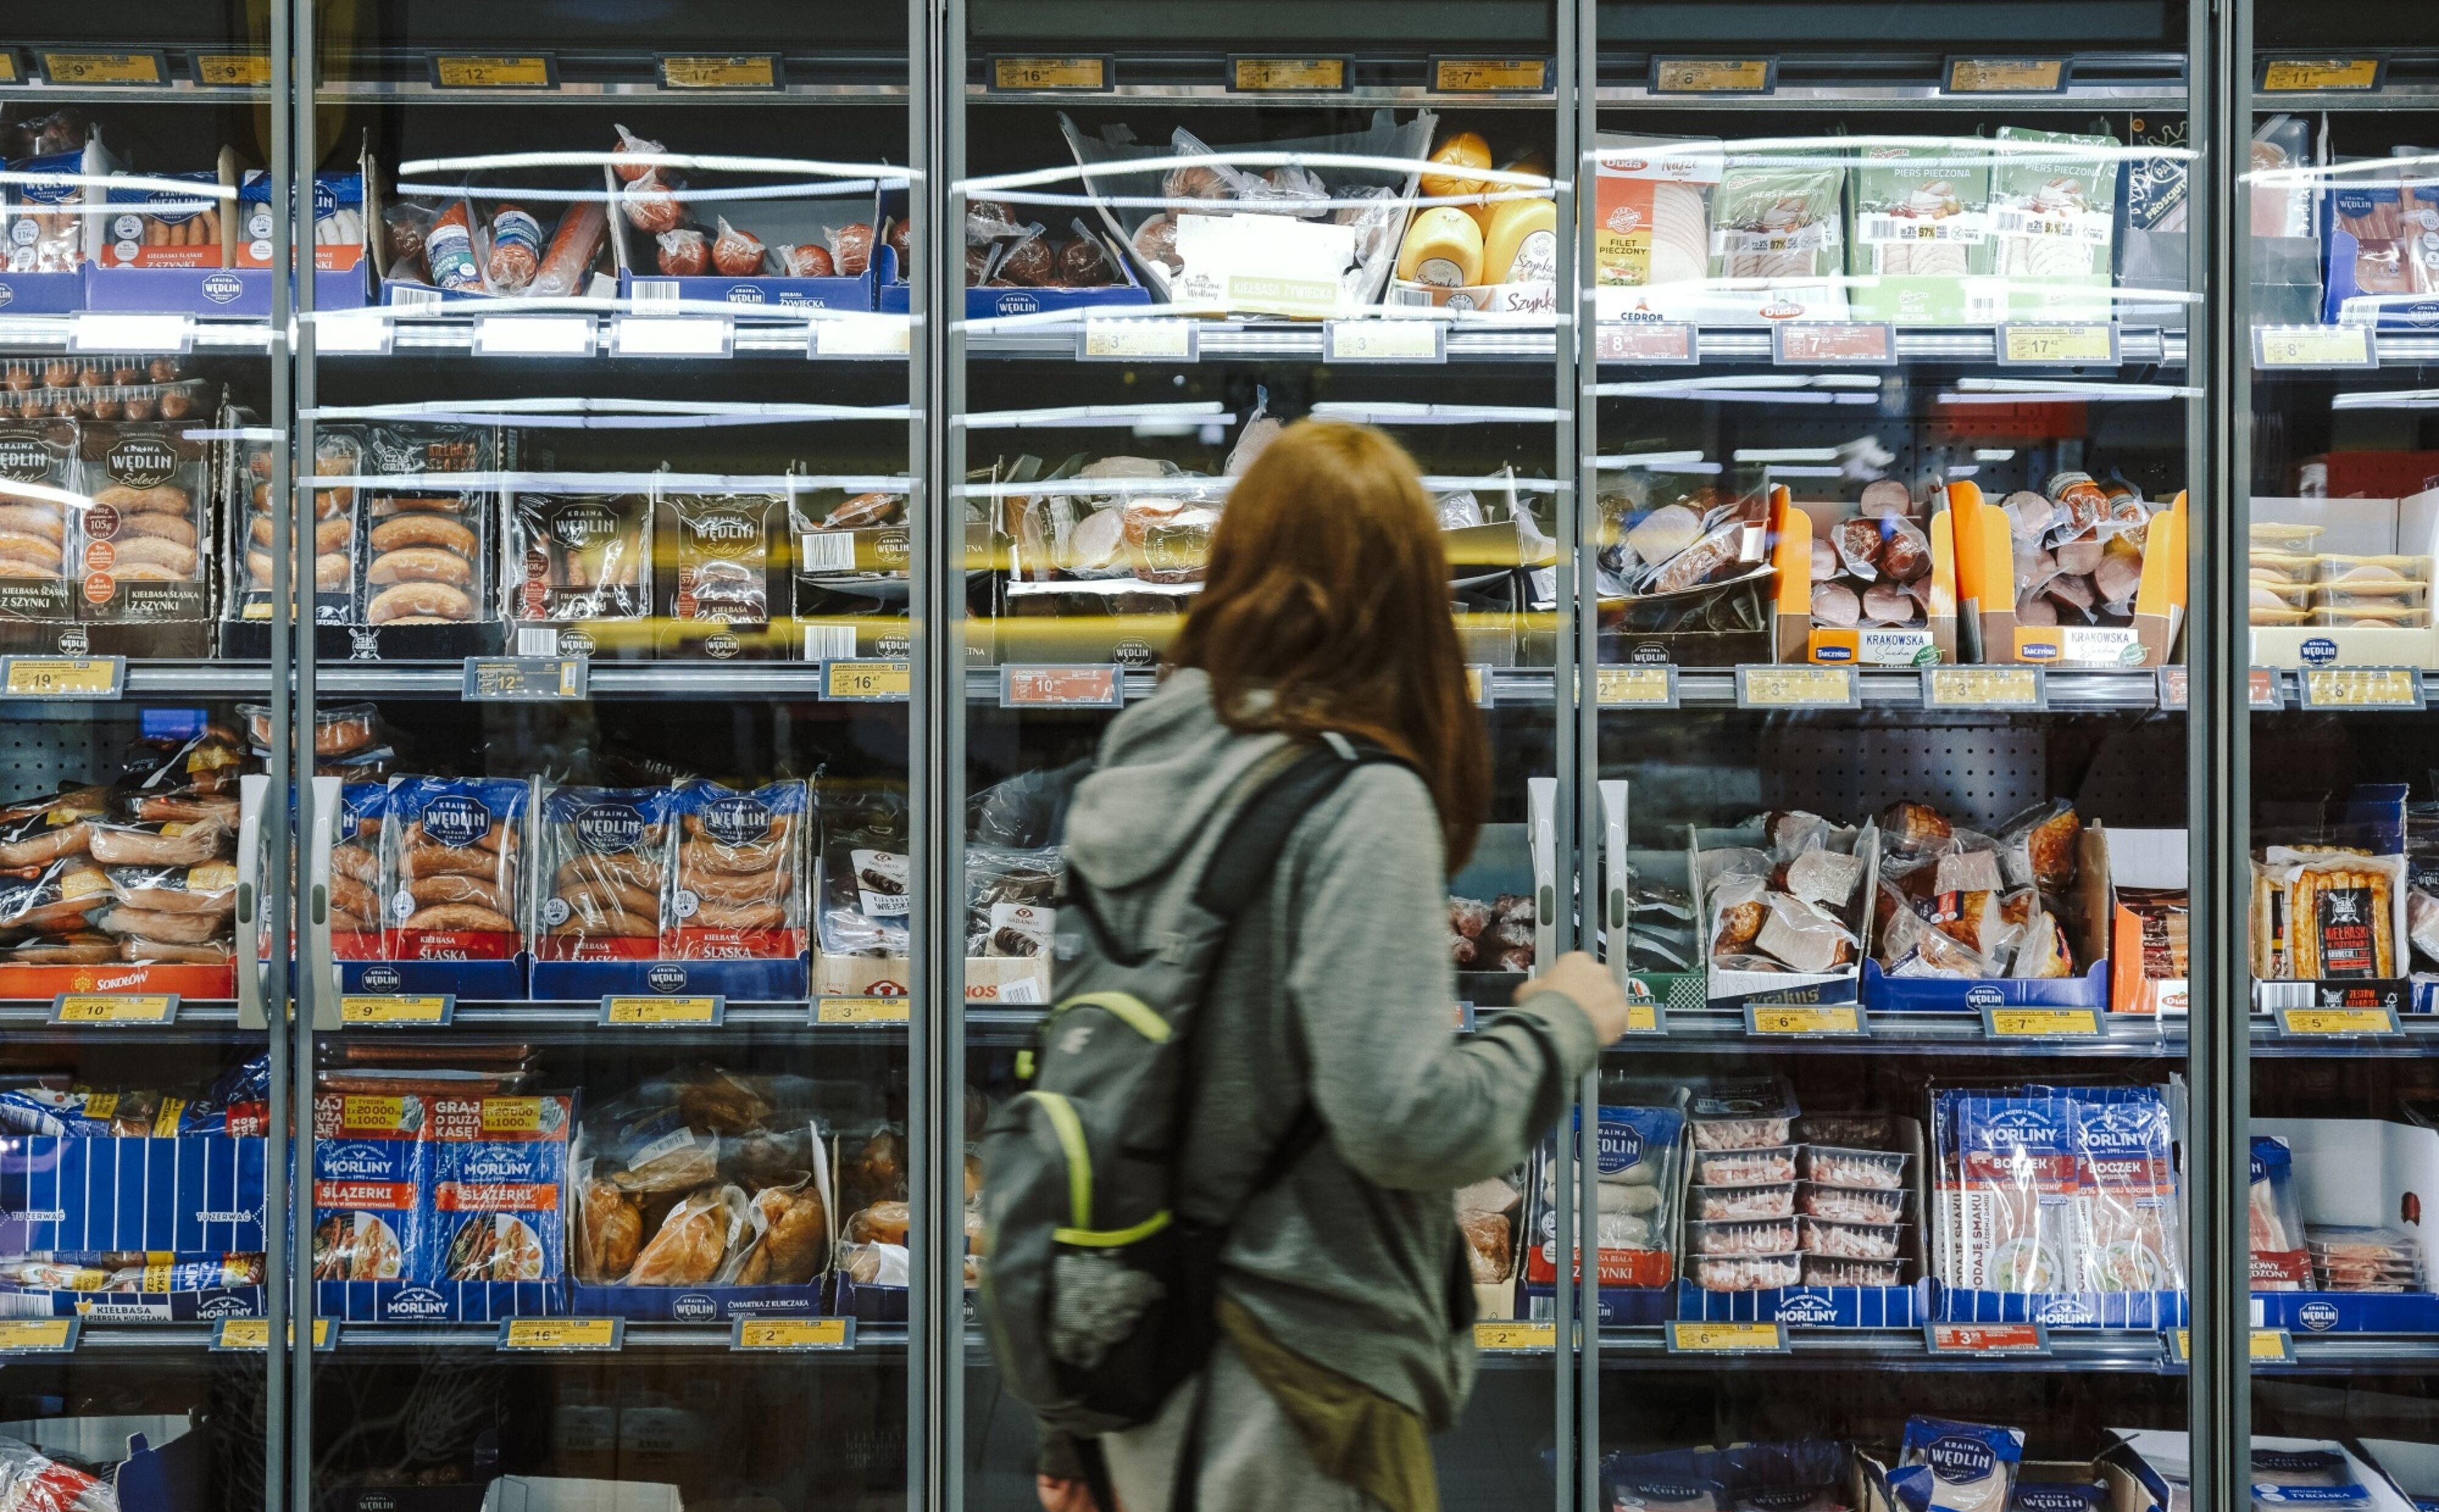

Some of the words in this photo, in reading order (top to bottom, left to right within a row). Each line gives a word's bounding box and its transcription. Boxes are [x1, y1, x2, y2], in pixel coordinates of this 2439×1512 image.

[465, 69, 483, 80] 12
[692, 70, 708, 81] 17
[1021, 70, 1040, 82] 16
[1894, 166, 1921, 177] PIERŚ
[1924, 168, 1971, 177] PIECZONA
[2340, 200, 2371, 211] WĘDLIN
[1919, 226, 1934, 238] 97%
[1599, 247, 1647, 256] PIECZONY
[206, 284, 240, 295] WĘDLIN
[1234, 282, 1279, 296] KIEŁBASA
[1283, 284, 1332, 300] ŻYWIECKA
[999, 303, 1035, 314] WĘDLIN
[1764, 306, 1799, 316] Duda
[1620, 312, 1663, 321] CEDROB
[1612, 336, 1622, 351] 8
[1809, 337, 1820, 352] 7
[2031, 340, 2048, 352] 17
[112, 456, 171, 471] WĘDLIN
[120, 473, 162, 485] Select
[556, 519, 614, 534] WĘDLIN
[695, 525, 754, 542] WĘDLIN
[877, 544, 909, 555] WĘDLIN
[170, 588, 199, 600] ŚLĄSKA
[10, 598, 49, 608] SZYNKI
[131, 601, 138, 610] Z
[140, 601, 179, 611] SZYNKI
[1866, 634, 1925, 646] KRAKOWSKA
[2071, 632, 2130, 643] KRAKOWSKA
[561, 639, 593, 650] WĘDLIN
[706, 640, 738, 650] WĘDLIN
[1116, 648, 1148, 659] WĘDLIN
[1817, 648, 1851, 659] TARCZYŃSKI
[2023, 645, 2057, 656] TARCZYŃSKI
[2302, 647, 2335, 658] WĘDLIN
[1634, 653, 1667, 664] WĘDLIN
[33, 674, 51, 686] 19
[498, 676, 514, 689] 12
[853, 676, 871, 689] 16
[1036, 679, 1054, 692] 10
[1599, 683, 1607, 696] 2
[1772, 683, 1780, 696] 3
[1958, 683, 1966, 696] 3
[439, 801, 473, 811] KRAINA
[427, 812, 485, 829] WĘDLIN
[710, 812, 767, 829] WĘDLIN
[580, 820, 644, 836] WĘDLIN
[2325, 927, 2368, 940] KIEŁBASKI
[420, 936, 455, 944] KIEŁBASA
[97, 970, 148, 991] SOKOŁÓW
[365, 976, 398, 986] WĘDLIN
[650, 973, 684, 984] WĘDLIN
[2348, 989, 2375, 998] ZESTAW
[1969, 995, 2001, 1006] WĘDLIN
[86, 1006, 103, 1016] 10
[364, 1007, 372, 1016] 9
[843, 1008, 852, 1017] 3
[1780, 1017, 1789, 1028] 6
[2018, 1019, 2026, 1029] 7
[2311, 1019, 2321, 1028] 5
[435, 1101, 480, 1114] GRAJ
[435, 1115, 445, 1125] O
[447, 1113, 481, 1127] DUŻĄ
[435, 1125, 478, 1139] KASĘ!
[1981, 1128, 2058, 1142] MORLINY
[324, 1160, 392, 1175] MORLINY
[464, 1163, 532, 1176] MORLINY
[2089, 1161, 2142, 1173] BOCZEK
[322, 1186, 392, 1202] ŚLĄZERKI
[463, 1188, 531, 1202] ŚLĄZERKI
[12, 1212, 23, 1221] TU
[26, 1209, 65, 1221] ZERWAĆ
[196, 1212, 209, 1221] TU
[211, 1209, 251, 1221] ZERWAĆ
[1972, 1194, 1983, 1239] SMAKU
[387, 1303, 448, 1314] MORLINY
[676, 1305, 714, 1316] WĘDLIN
[1775, 1310, 1838, 1322] MORLINY
[2036, 1313, 2094, 1324] MORLINY
[2302, 1311, 2338, 1322] WĘDLIN
[534, 1330, 550, 1341] 16
[766, 1330, 775, 1341] 2
[1498, 1334, 1507, 1343] 2
[1701, 1334, 1709, 1343] 6
[1959, 1331, 1972, 1345] 3
[1945, 1440, 1980, 1453] KRAINA
[1931, 1449, 1990, 1470] WĘDLIN
[2290, 1491, 2351, 1500] TYROLSKA
[359, 1502, 394, 1511] WĘDLIN
[2023, 1497, 2083, 1510] WĘDLIN
